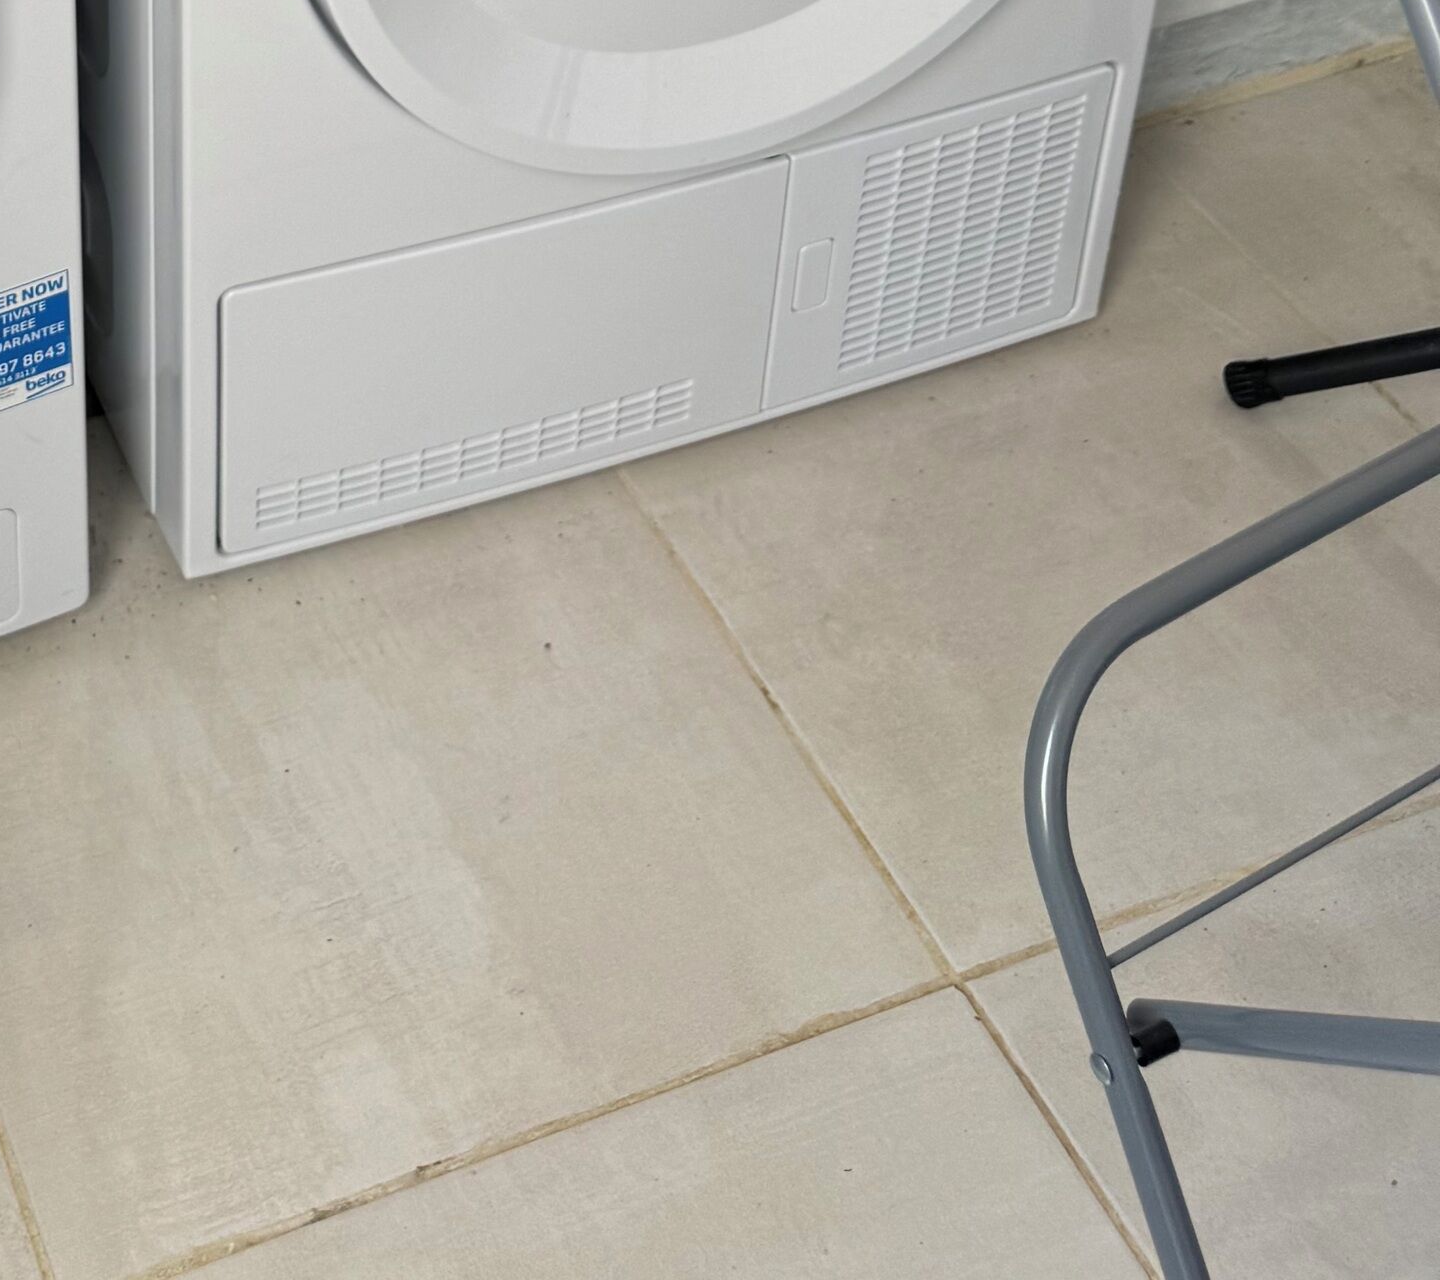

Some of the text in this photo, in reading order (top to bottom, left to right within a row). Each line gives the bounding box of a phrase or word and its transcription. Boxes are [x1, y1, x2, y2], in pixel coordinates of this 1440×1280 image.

[22, 276, 64, 301] NOW
[3, 318, 36, 338] FREE
[23, 342, 66, 367] 8643
[26, 370, 66, 391] beko
